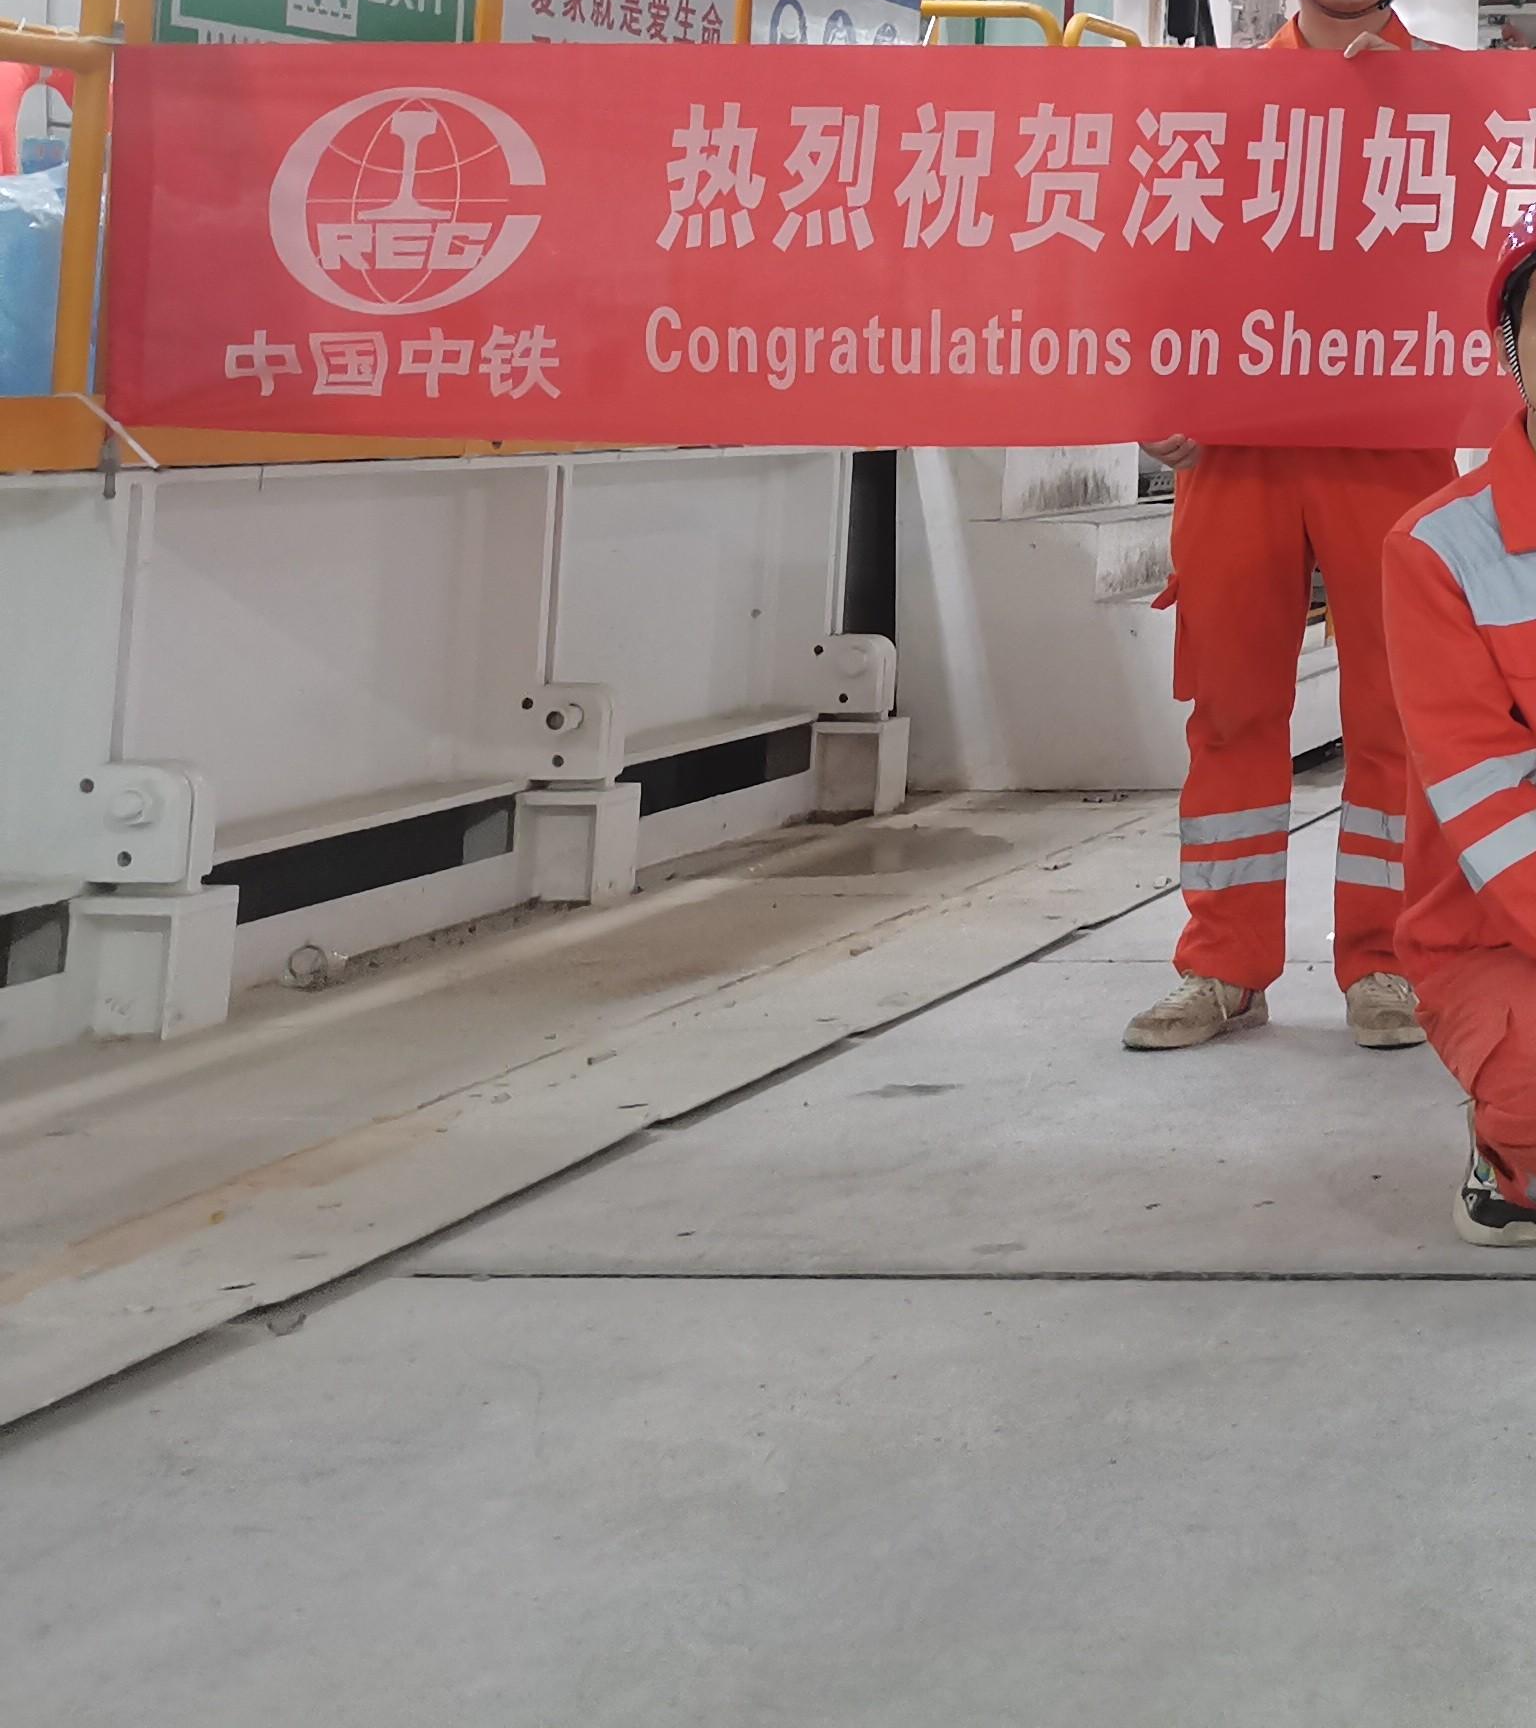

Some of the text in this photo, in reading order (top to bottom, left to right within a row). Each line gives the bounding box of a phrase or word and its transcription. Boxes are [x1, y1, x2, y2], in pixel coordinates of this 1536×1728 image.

[224, 324, 562, 400] 中国中铁
[644, 305, 1132, 391] Congratulations
[1149, 326, 1220, 377] on
[1238, 308, 1507, 379] Shenzhe
